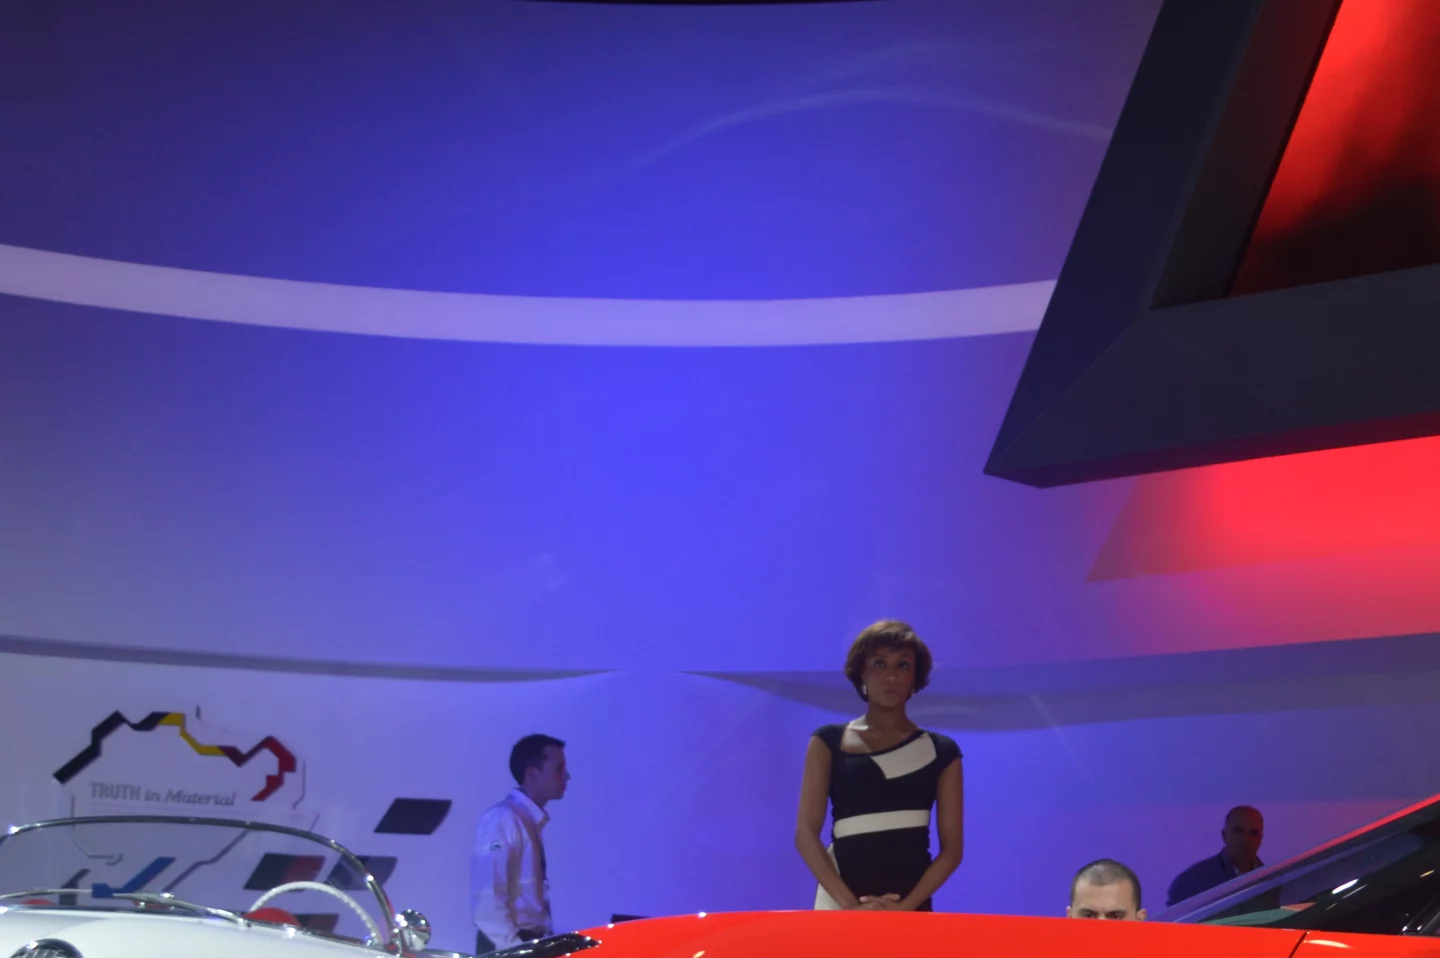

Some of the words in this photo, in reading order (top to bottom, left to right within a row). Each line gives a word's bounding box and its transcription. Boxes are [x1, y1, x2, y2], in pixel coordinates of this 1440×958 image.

[89, 781, 141, 801] TRUTH
[144, 789, 161, 803] in
[163, 788, 237, 807] Material
